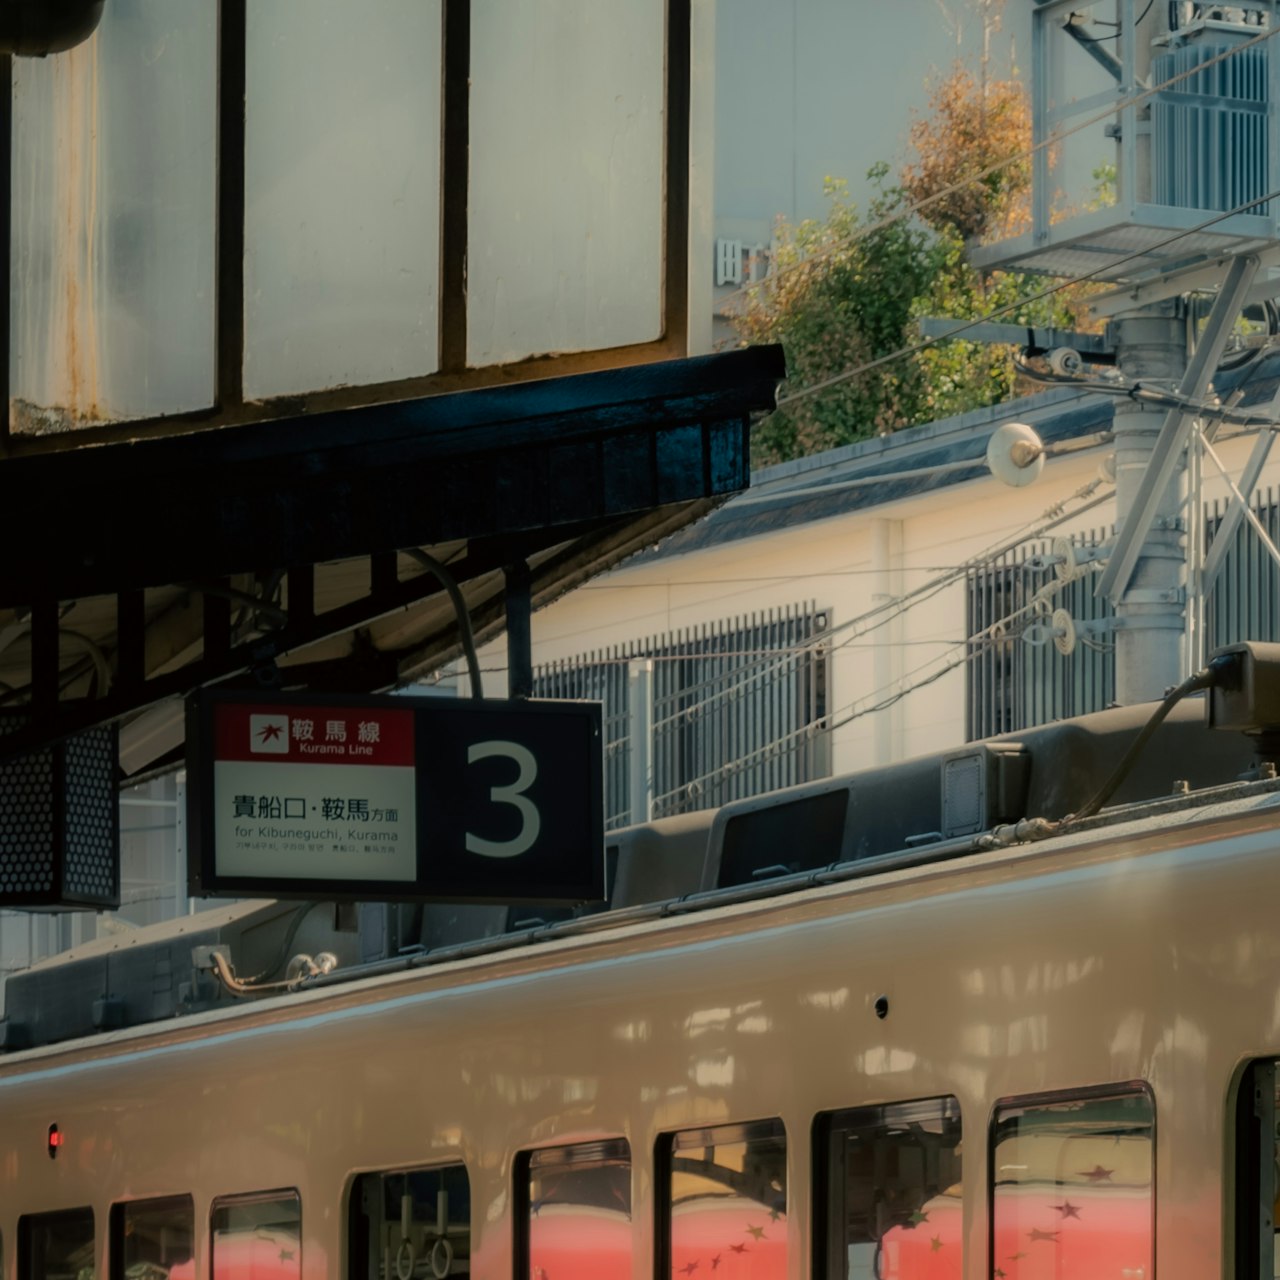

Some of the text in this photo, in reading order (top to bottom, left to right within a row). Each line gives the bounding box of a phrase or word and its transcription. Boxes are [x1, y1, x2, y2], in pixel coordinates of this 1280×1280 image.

[291, 718, 381, 743] 鞍馬線
[300, 743, 373, 755] Kurama Line
[465, 740, 541, 858] 3
[235, 825, 398, 842] for Kibuneguchi, Kurama
